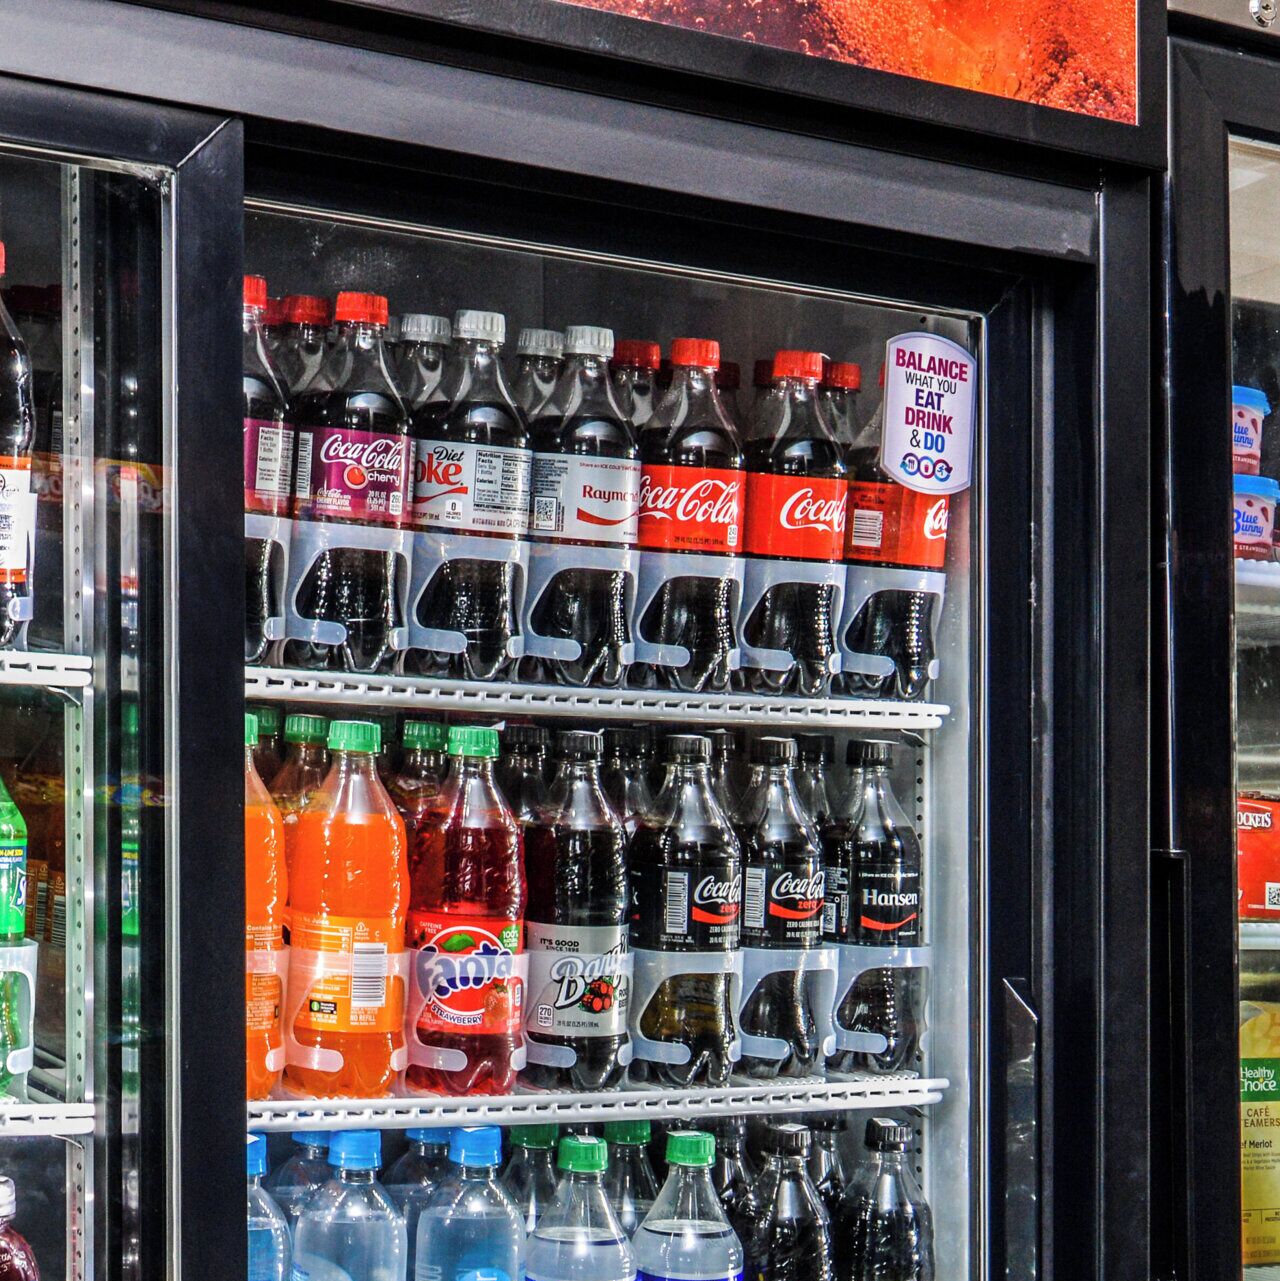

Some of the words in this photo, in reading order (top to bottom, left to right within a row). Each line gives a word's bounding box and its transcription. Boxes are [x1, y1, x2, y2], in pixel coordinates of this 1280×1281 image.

[895, 347, 968, 383] BALANCE
[905, 371, 933, 389] WHAT
[937, 379, 957, 395] YOU
[915, 388, 945, 414] EAT,
[904, 406, 954, 435] DRINK
[910, 429, 921, 449] &
[924, 432, 946, 454] DO
[319, 433, 405, 470] Coca-Cola
[433, 445, 466, 462] Diet
[367, 469, 400, 486] cherry
[797, 900, 818, 910] zero
[862, 889, 918, 907] Hansen
[502, 930, 519, 940] 100%
[540, 938, 554, 946] IT'S
[415, 941, 514, 1000] Fanta
[431, 1005, 483, 1025] STRAWBERRY
[539, 1006, 552, 1017] 270
[1241, 1066, 1276, 1083] Healthy
[1241, 1076, 1278, 1092] Choice
[1246, 1105, 1270, 1117] CAFÉ
[1248, 1139, 1273, 1149] Merlot
